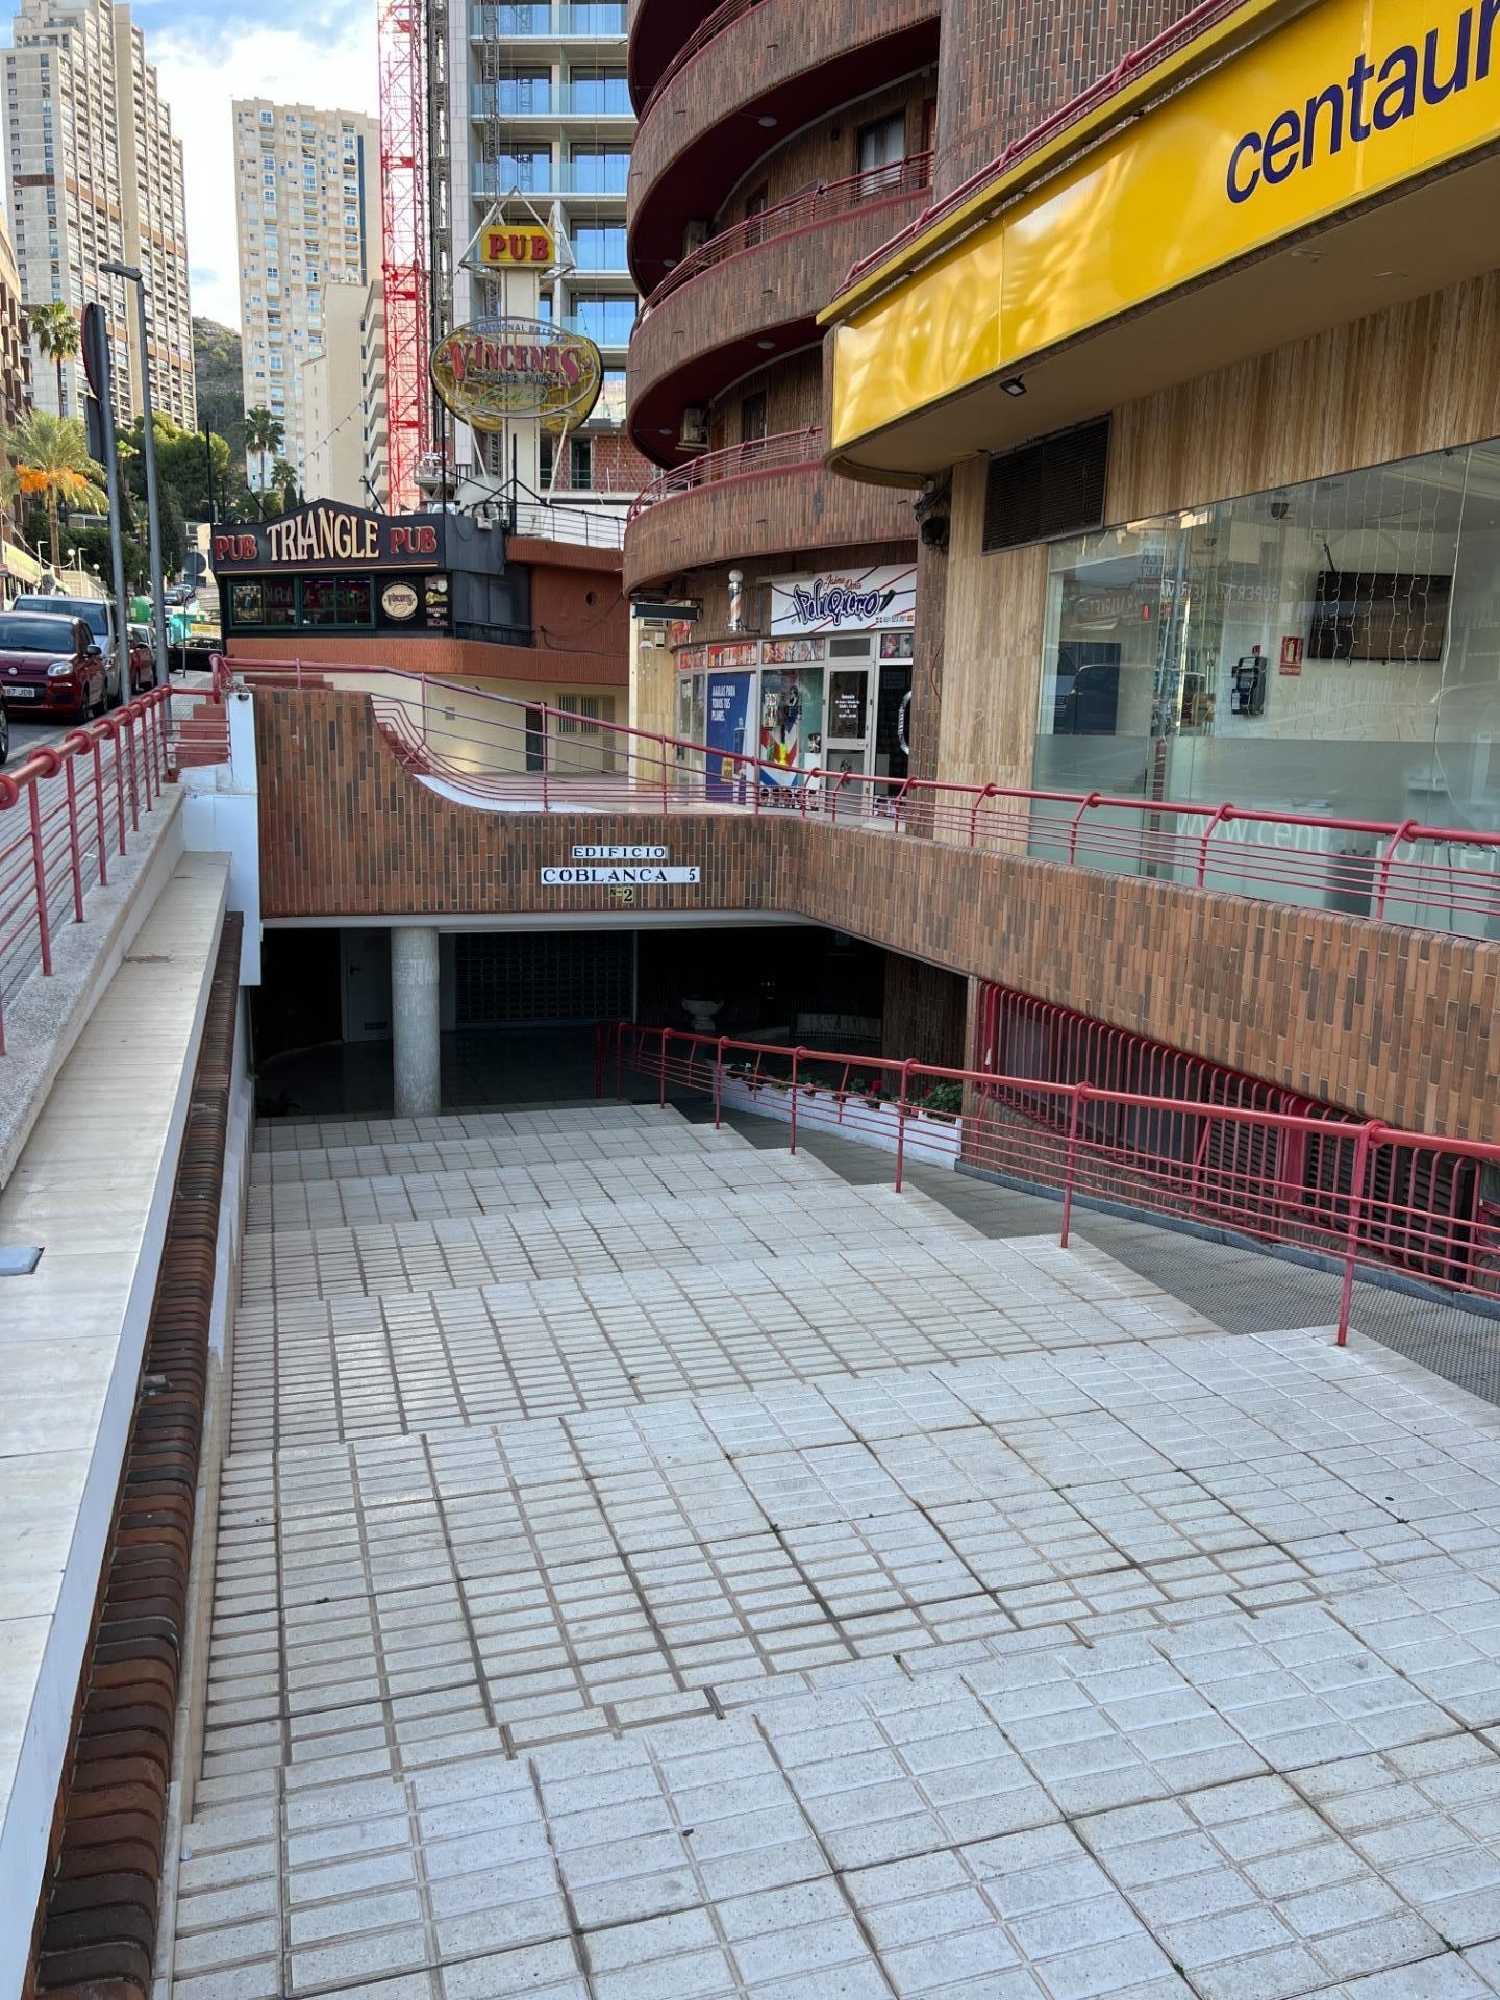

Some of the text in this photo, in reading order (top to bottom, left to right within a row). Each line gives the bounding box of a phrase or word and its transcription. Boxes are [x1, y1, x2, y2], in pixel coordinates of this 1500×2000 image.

[489, 233, 549, 261] PUB
[215, 507, 437, 562] PUB TRIANGLE PUB
[573, 847, 665, 858] EDIFICIO
[543, 868, 696, 883] COBLANCA 5
